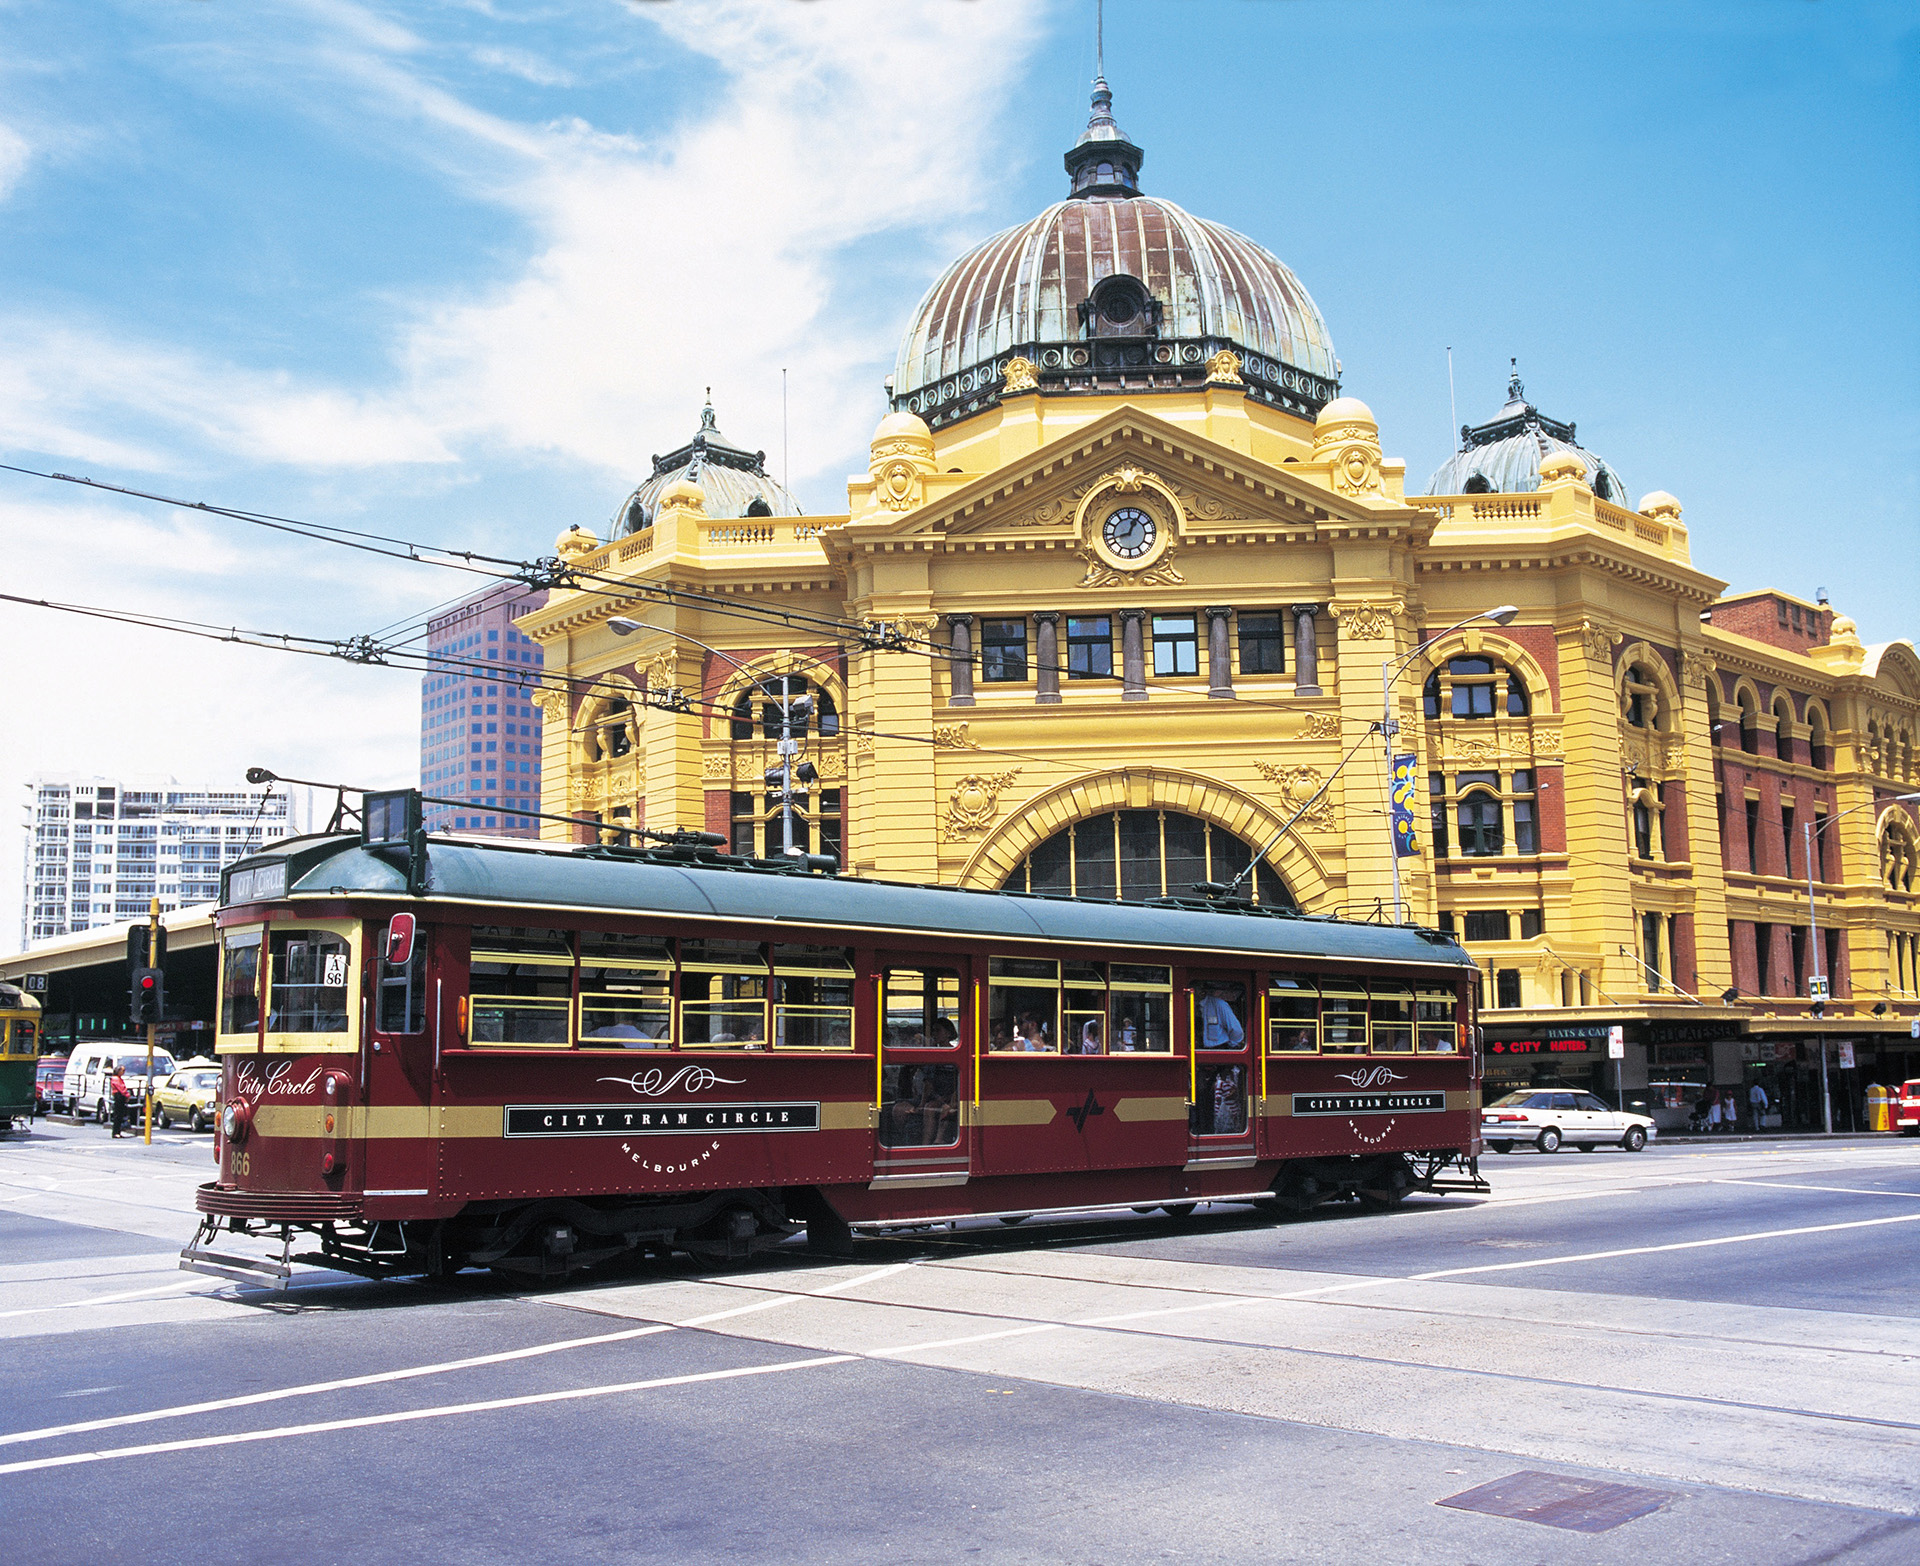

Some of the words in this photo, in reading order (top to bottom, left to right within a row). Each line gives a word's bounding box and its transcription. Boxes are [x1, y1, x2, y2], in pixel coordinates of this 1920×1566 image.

[257, 868, 286, 892] CIRCLE
[330, 959, 340, 971] A
[28, 976, 45, 989] 08
[326, 972, 341, 985] 86
[1549, 1029, 1576, 1038] HATS
[1578, 1028, 1586, 1037] &
[1588, 1026, 1609, 1037] CAP
[1510, 1041, 1541, 1052] CITY
[1550, 1040, 1587, 1052] HATTERS
[237, 1060, 265, 1105] City
[265, 1060, 323, 1095] Circle
[1310, 1100, 1341, 1109] CITY
[1349, 1099, 1380, 1108] TRAM
[1388, 1097, 1431, 1107] CIRCLE
[543, 1115, 605, 1126] CITY
[624, 1113, 687, 1125] TRAM
[705, 1111, 789, 1124] CIRCLE
[1348, 1118, 1396, 1144] MELBOURNE
[231, 1151, 250, 1176] 866
[621, 1141, 720, 1174] MELBOURNE
